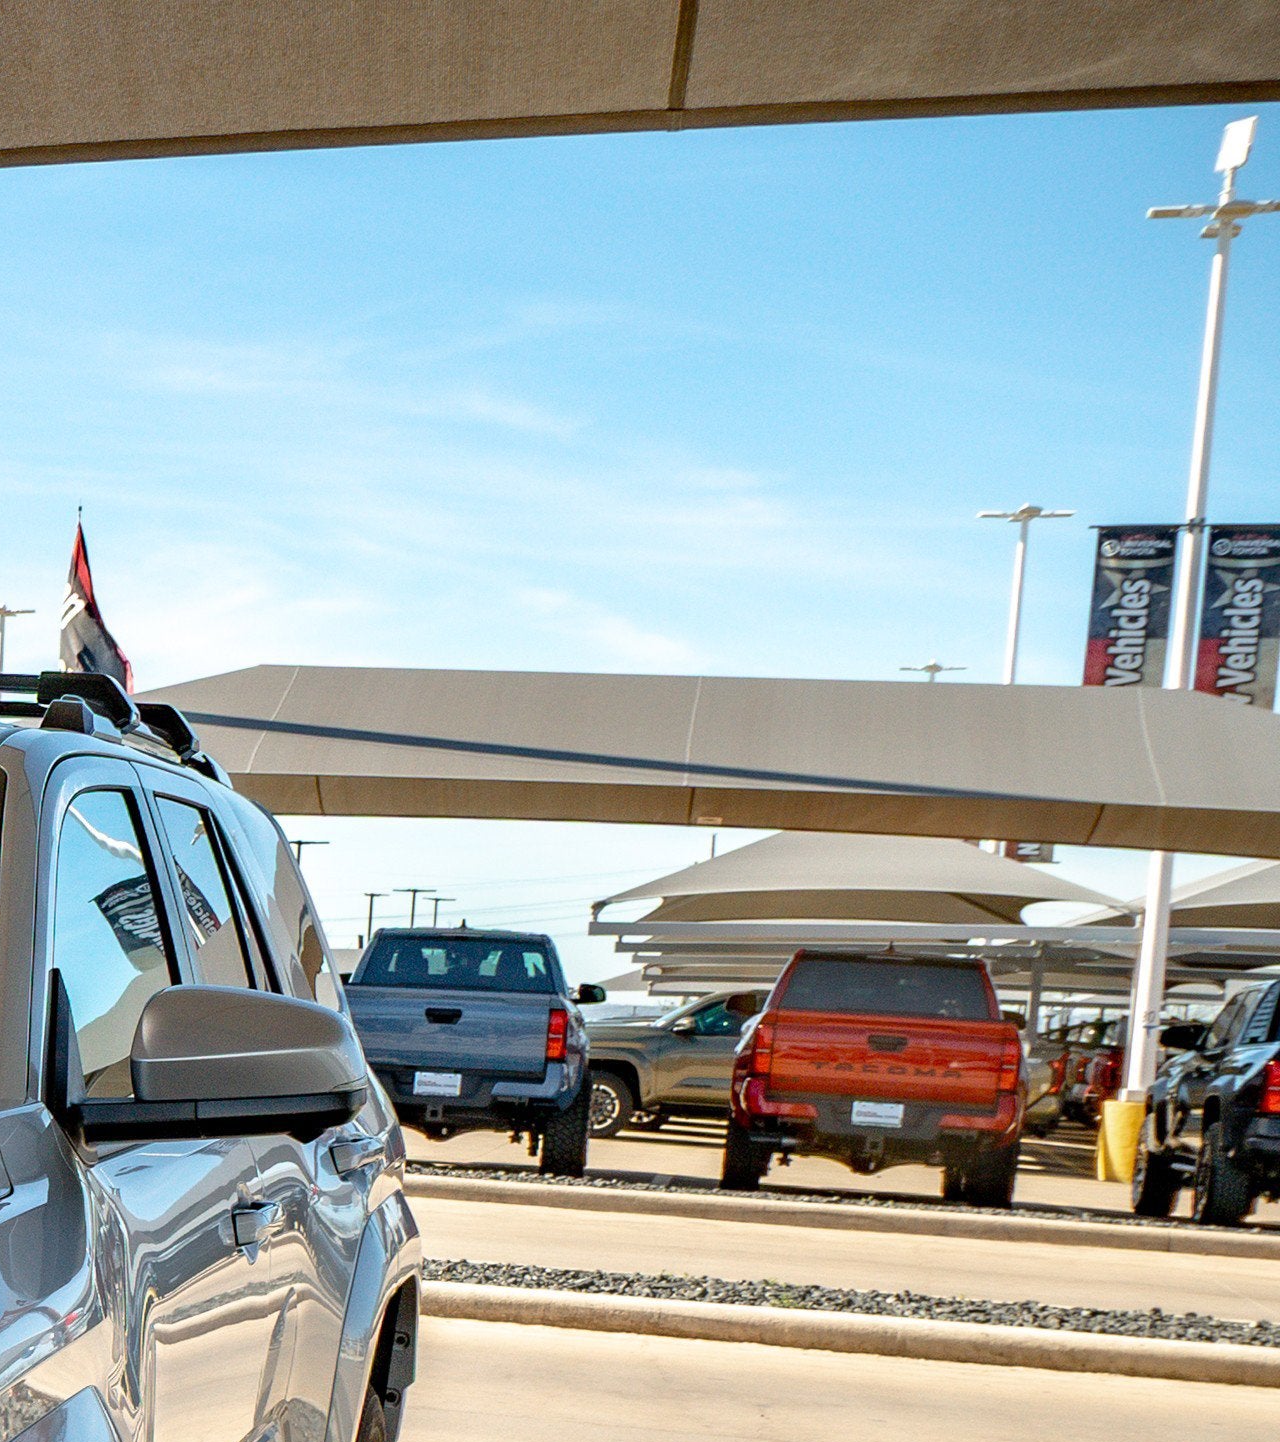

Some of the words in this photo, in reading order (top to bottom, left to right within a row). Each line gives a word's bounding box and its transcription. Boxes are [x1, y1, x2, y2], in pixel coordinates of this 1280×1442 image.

[1104, 578, 1151, 687] Vehicles
[1216, 578, 1263, 687] Vehicles
[811, 1061, 961, 1078] TACOMA
